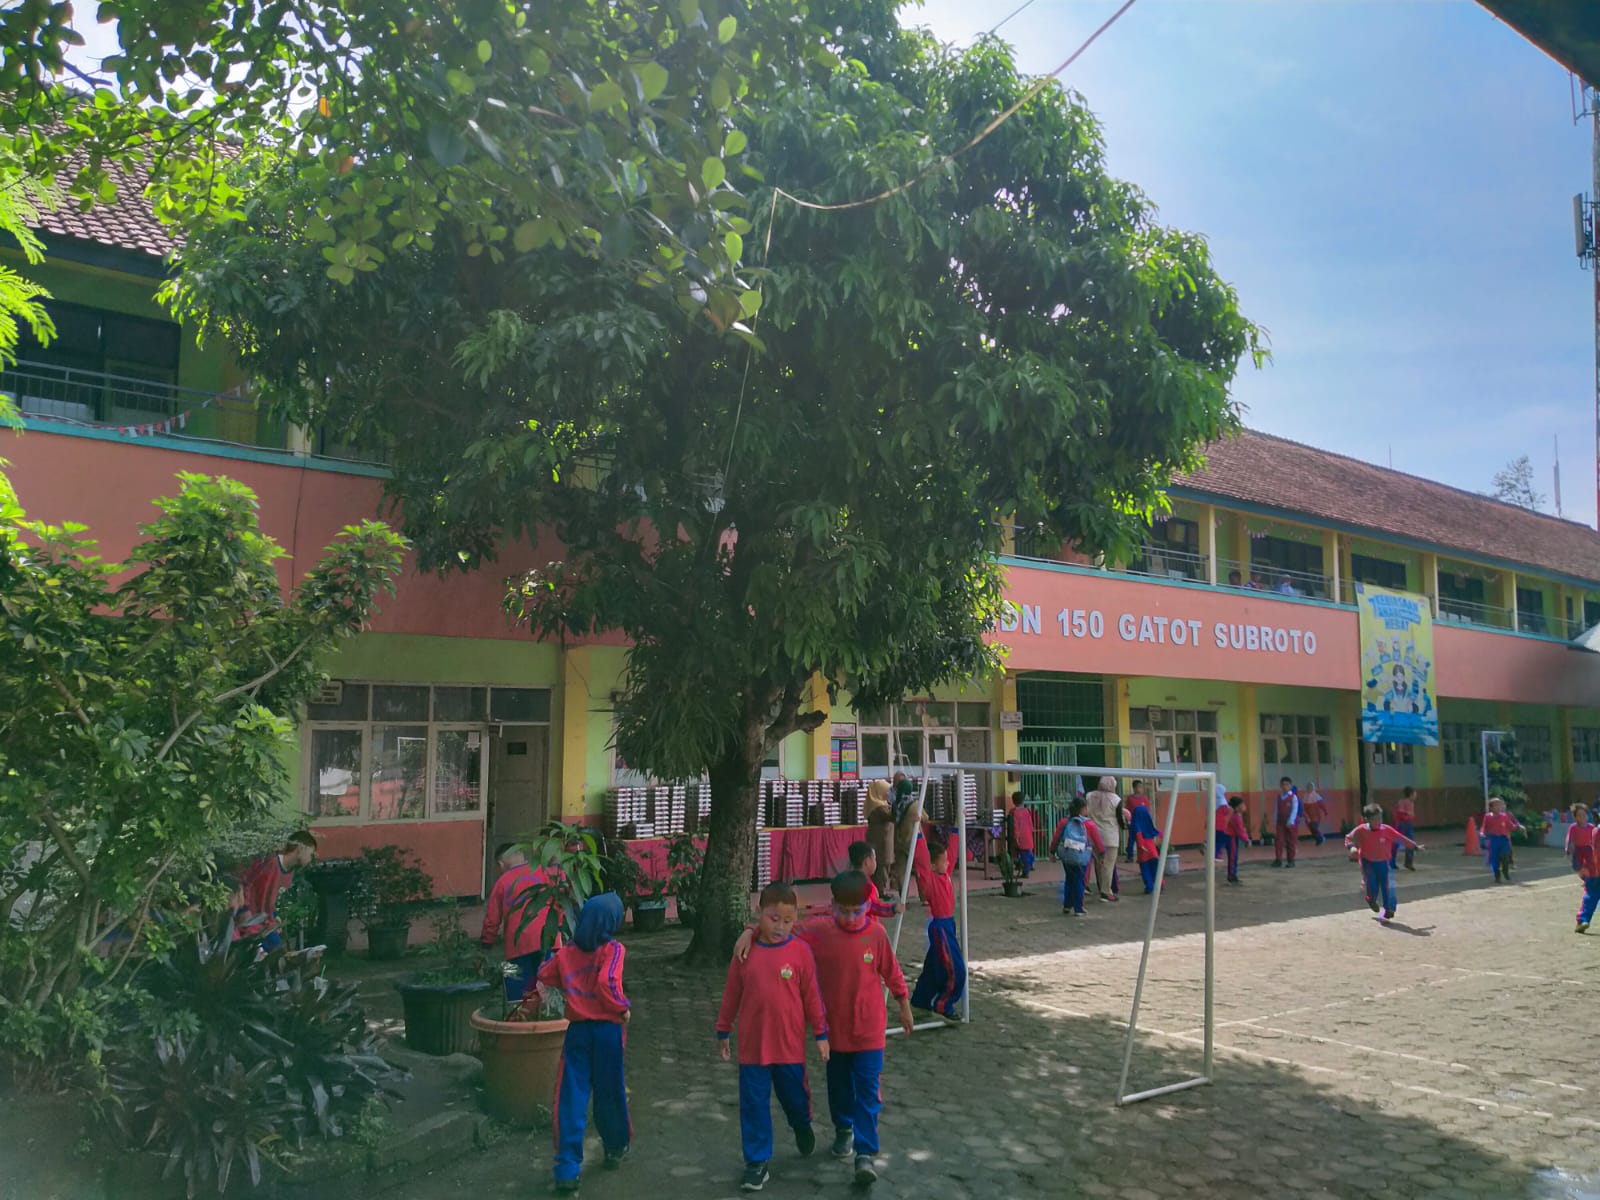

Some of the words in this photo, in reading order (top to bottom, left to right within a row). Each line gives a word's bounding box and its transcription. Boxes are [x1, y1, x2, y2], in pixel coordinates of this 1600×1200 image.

[1057, 608, 1104, 638] 150
[1119, 613, 1201, 646] GATOT
[1214, 623, 1317, 655] SUBROTO
